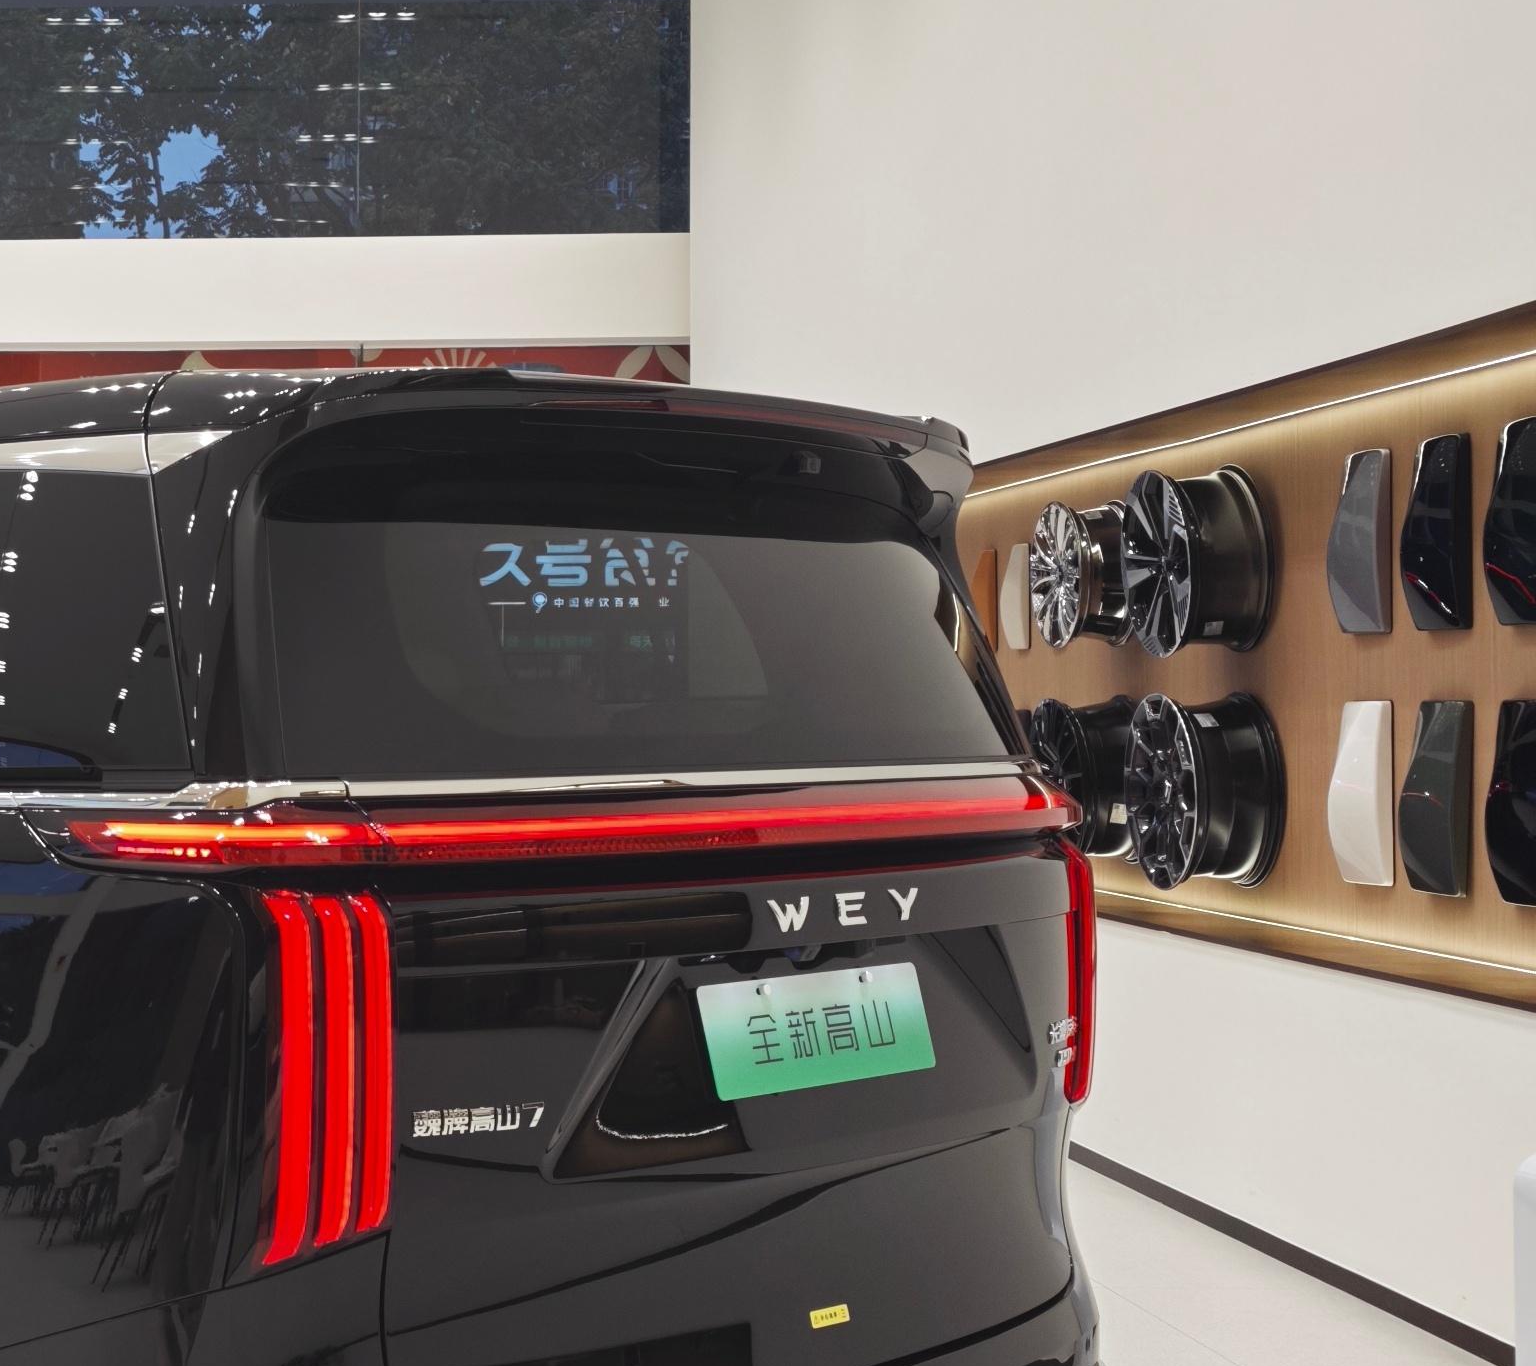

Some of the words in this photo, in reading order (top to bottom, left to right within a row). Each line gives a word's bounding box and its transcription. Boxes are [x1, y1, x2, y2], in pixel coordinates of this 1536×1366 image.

[766, 887, 919, 933] WEY
[746, 999, 897, 1066] 全新高山
